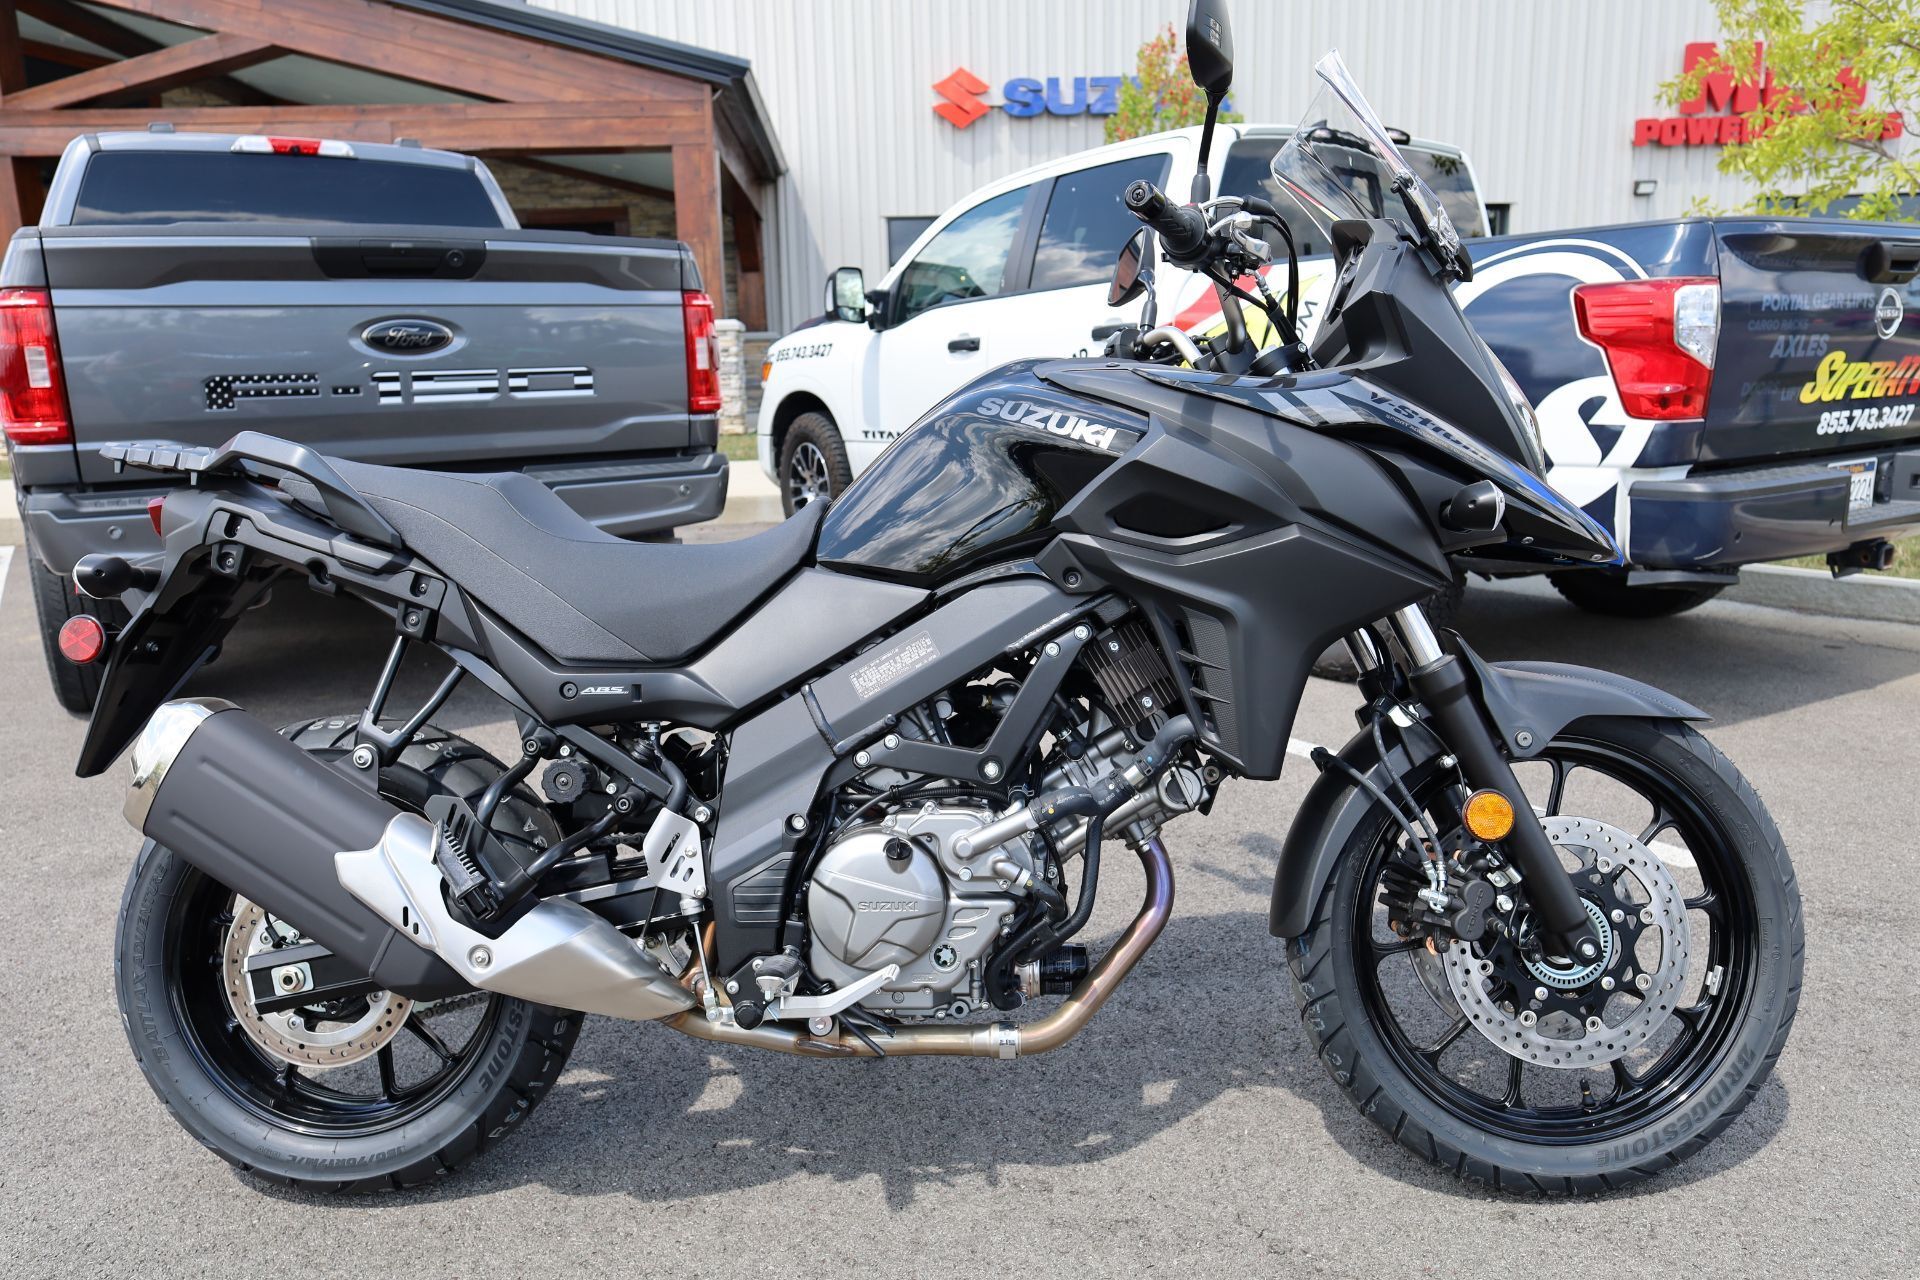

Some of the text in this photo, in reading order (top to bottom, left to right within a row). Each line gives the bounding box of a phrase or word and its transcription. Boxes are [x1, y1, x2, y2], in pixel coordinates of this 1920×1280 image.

[1762, 294, 1810, 312] PORTAL
[384, 326, 433, 348] Ford
[1770, 334, 1830, 359] AXLES
[976, 397, 1117, 450] SUZUKI
[1817, 404, 1915, 435] 855.743.3427
[580, 686, 624, 695] ABS
[857, 901, 919, 912] SUZUKI
[1593, 1043, 1757, 1168] BRIDGESTONE
